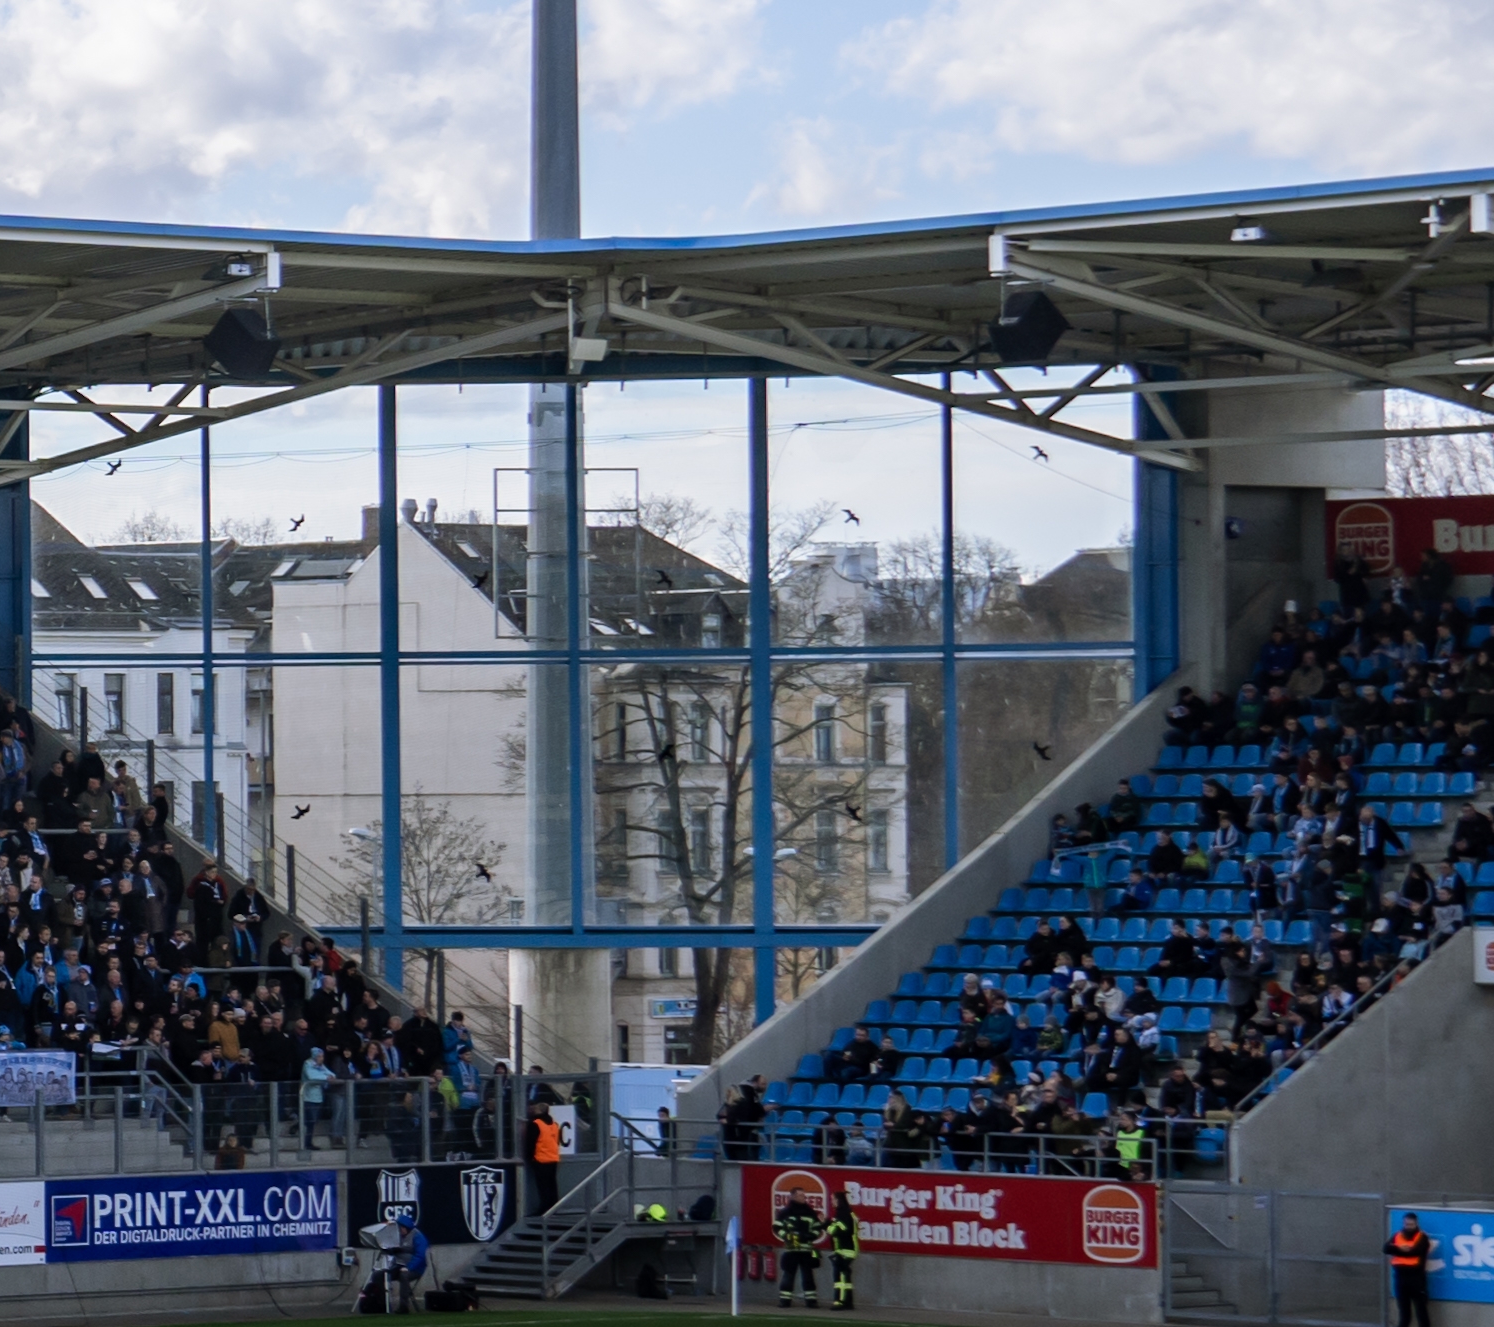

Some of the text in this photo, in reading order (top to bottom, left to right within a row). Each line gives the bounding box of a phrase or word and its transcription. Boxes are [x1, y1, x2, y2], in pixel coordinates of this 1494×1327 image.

[1352, 540, 1390, 558] ING
[559, 1121, 572, 1149] C
[93, 1184, 333, 1228] PRINT-XXL.COM
[845, 1181, 998, 1221] Burger King
[1085, 1209, 1140, 1225] BURGER
[93, 1229, 117, 1246] DER
[257, 1224, 270, 1239] IN
[272, 1221, 332, 1239] CHEMNITZ
[858, 1217, 1026, 1250] amilien Block
[1086, 1225, 1140, 1246] KING
